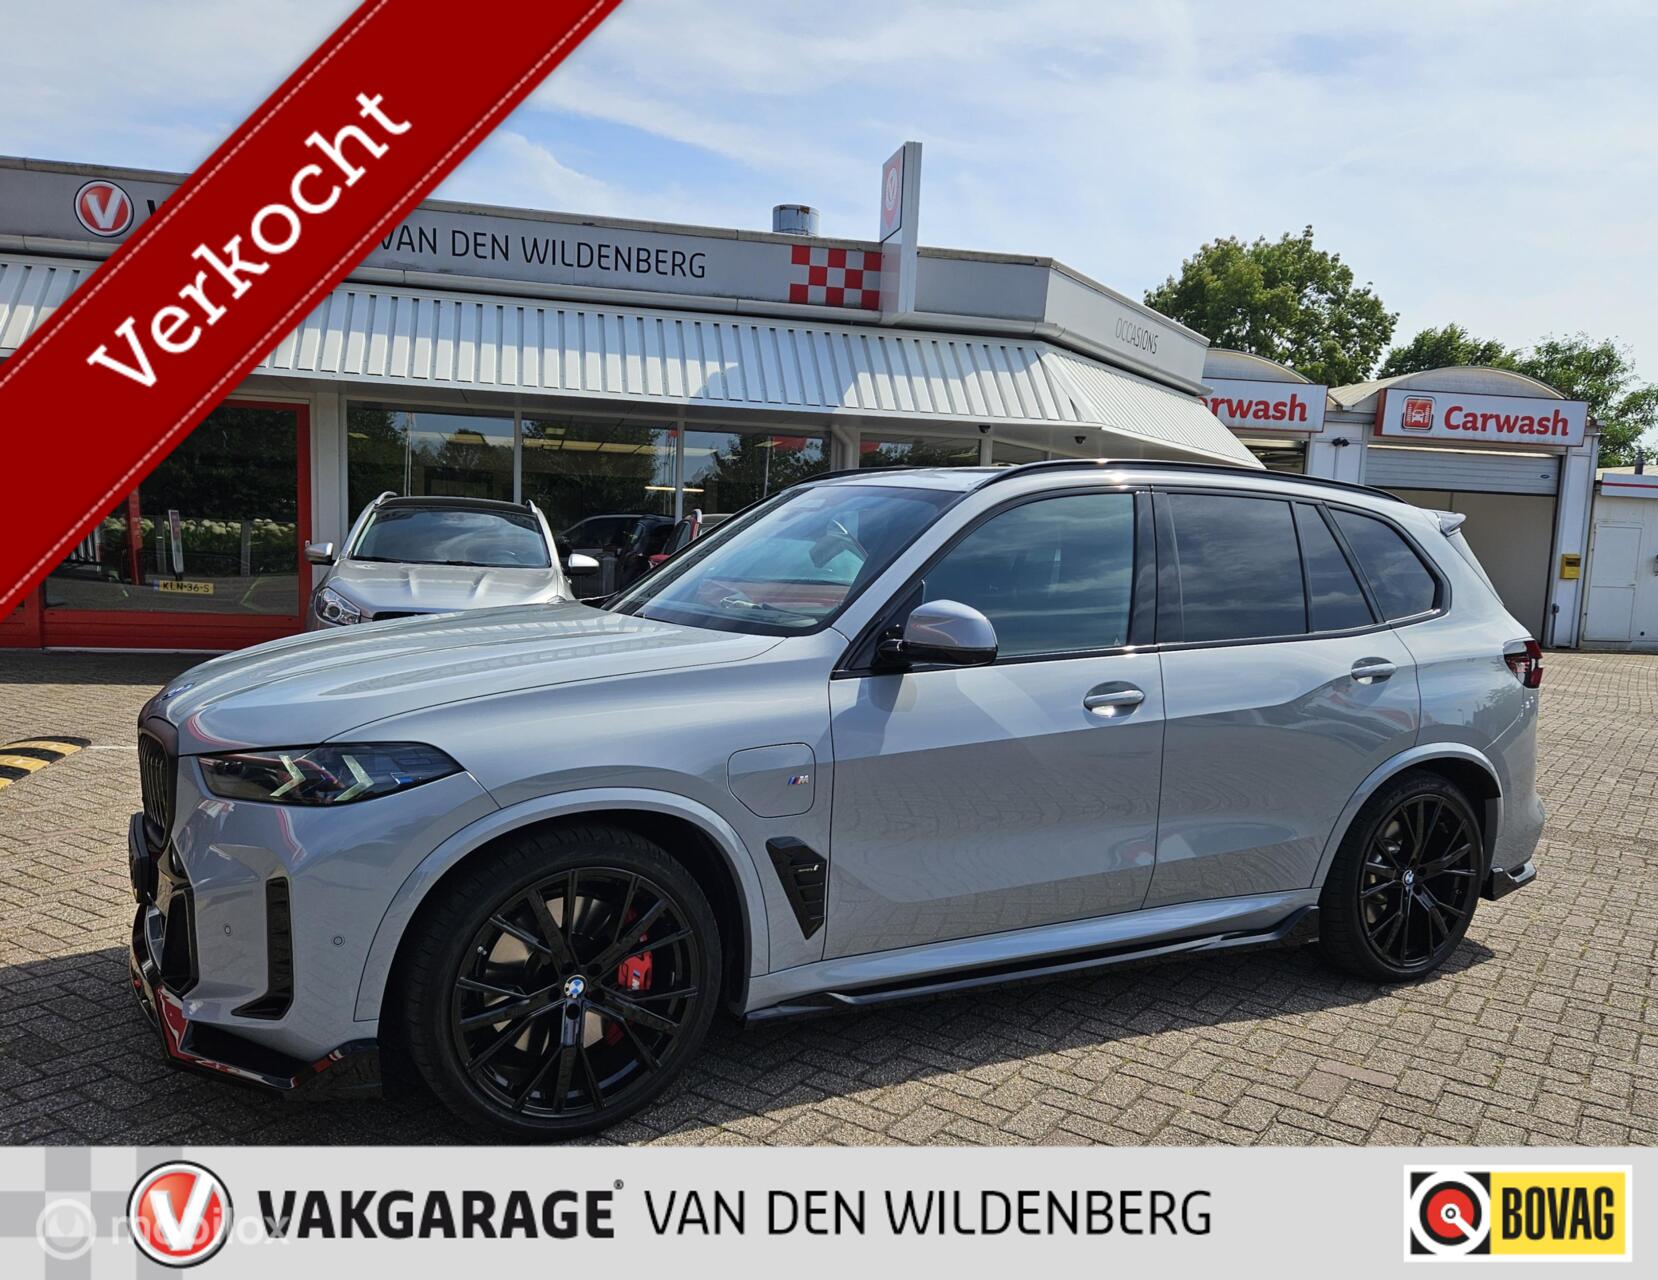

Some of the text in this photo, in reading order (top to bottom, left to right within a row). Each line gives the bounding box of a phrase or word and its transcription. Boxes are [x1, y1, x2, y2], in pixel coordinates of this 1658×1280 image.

[451, 229, 510, 262] DEN
[521, 236, 707, 279] WILDENBERG
[1115, 317, 1159, 355] OCCASIONS
[1444, 405, 1569, 437] Carwash
